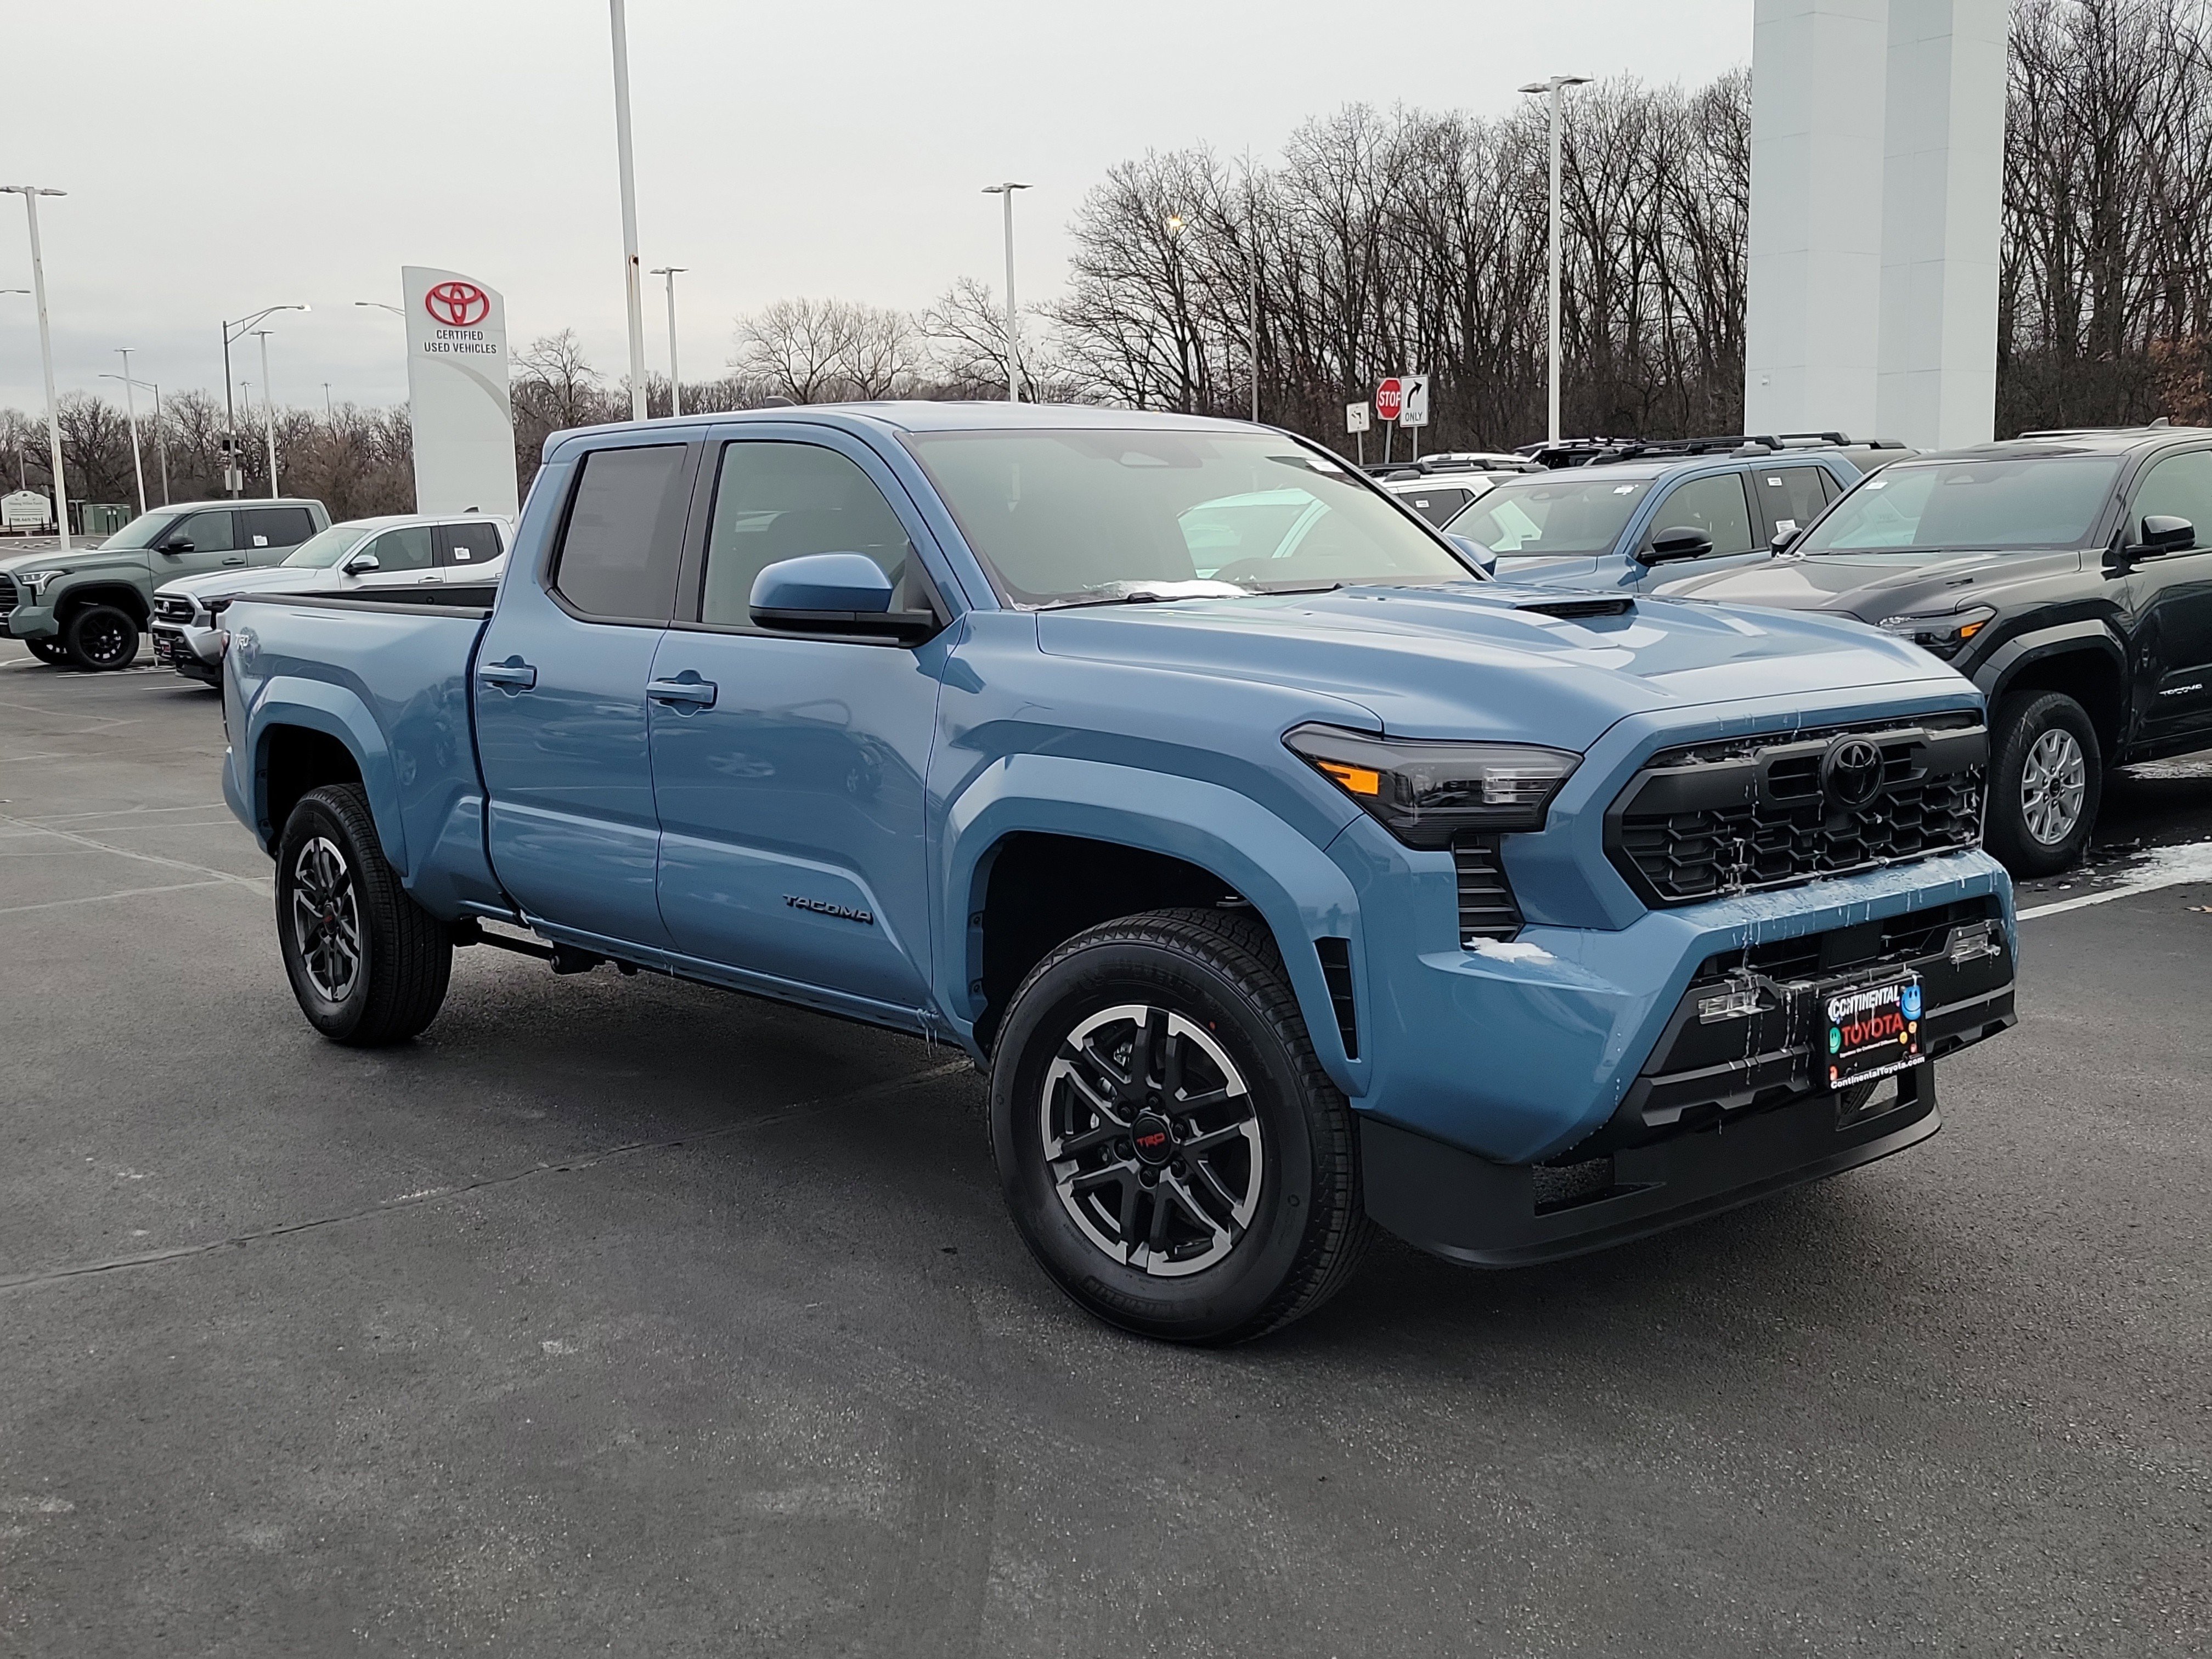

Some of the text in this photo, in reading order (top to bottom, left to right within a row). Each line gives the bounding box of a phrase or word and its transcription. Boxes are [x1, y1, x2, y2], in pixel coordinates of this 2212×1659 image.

[437, 330, 483, 341] CERTIFIED
[424, 342, 496, 354] USED VEHICLES
[1405, 411, 1423, 422] ONLY
[782, 894, 874, 925] TACOMA
[1828, 985, 1900, 1022] CONTINENTAL
[1842, 1013, 1904, 1046] TOYOTA
[1830, 1056, 1925, 1089] ContinentalToyota.com
[1137, 1133, 1165, 1147] TRD
